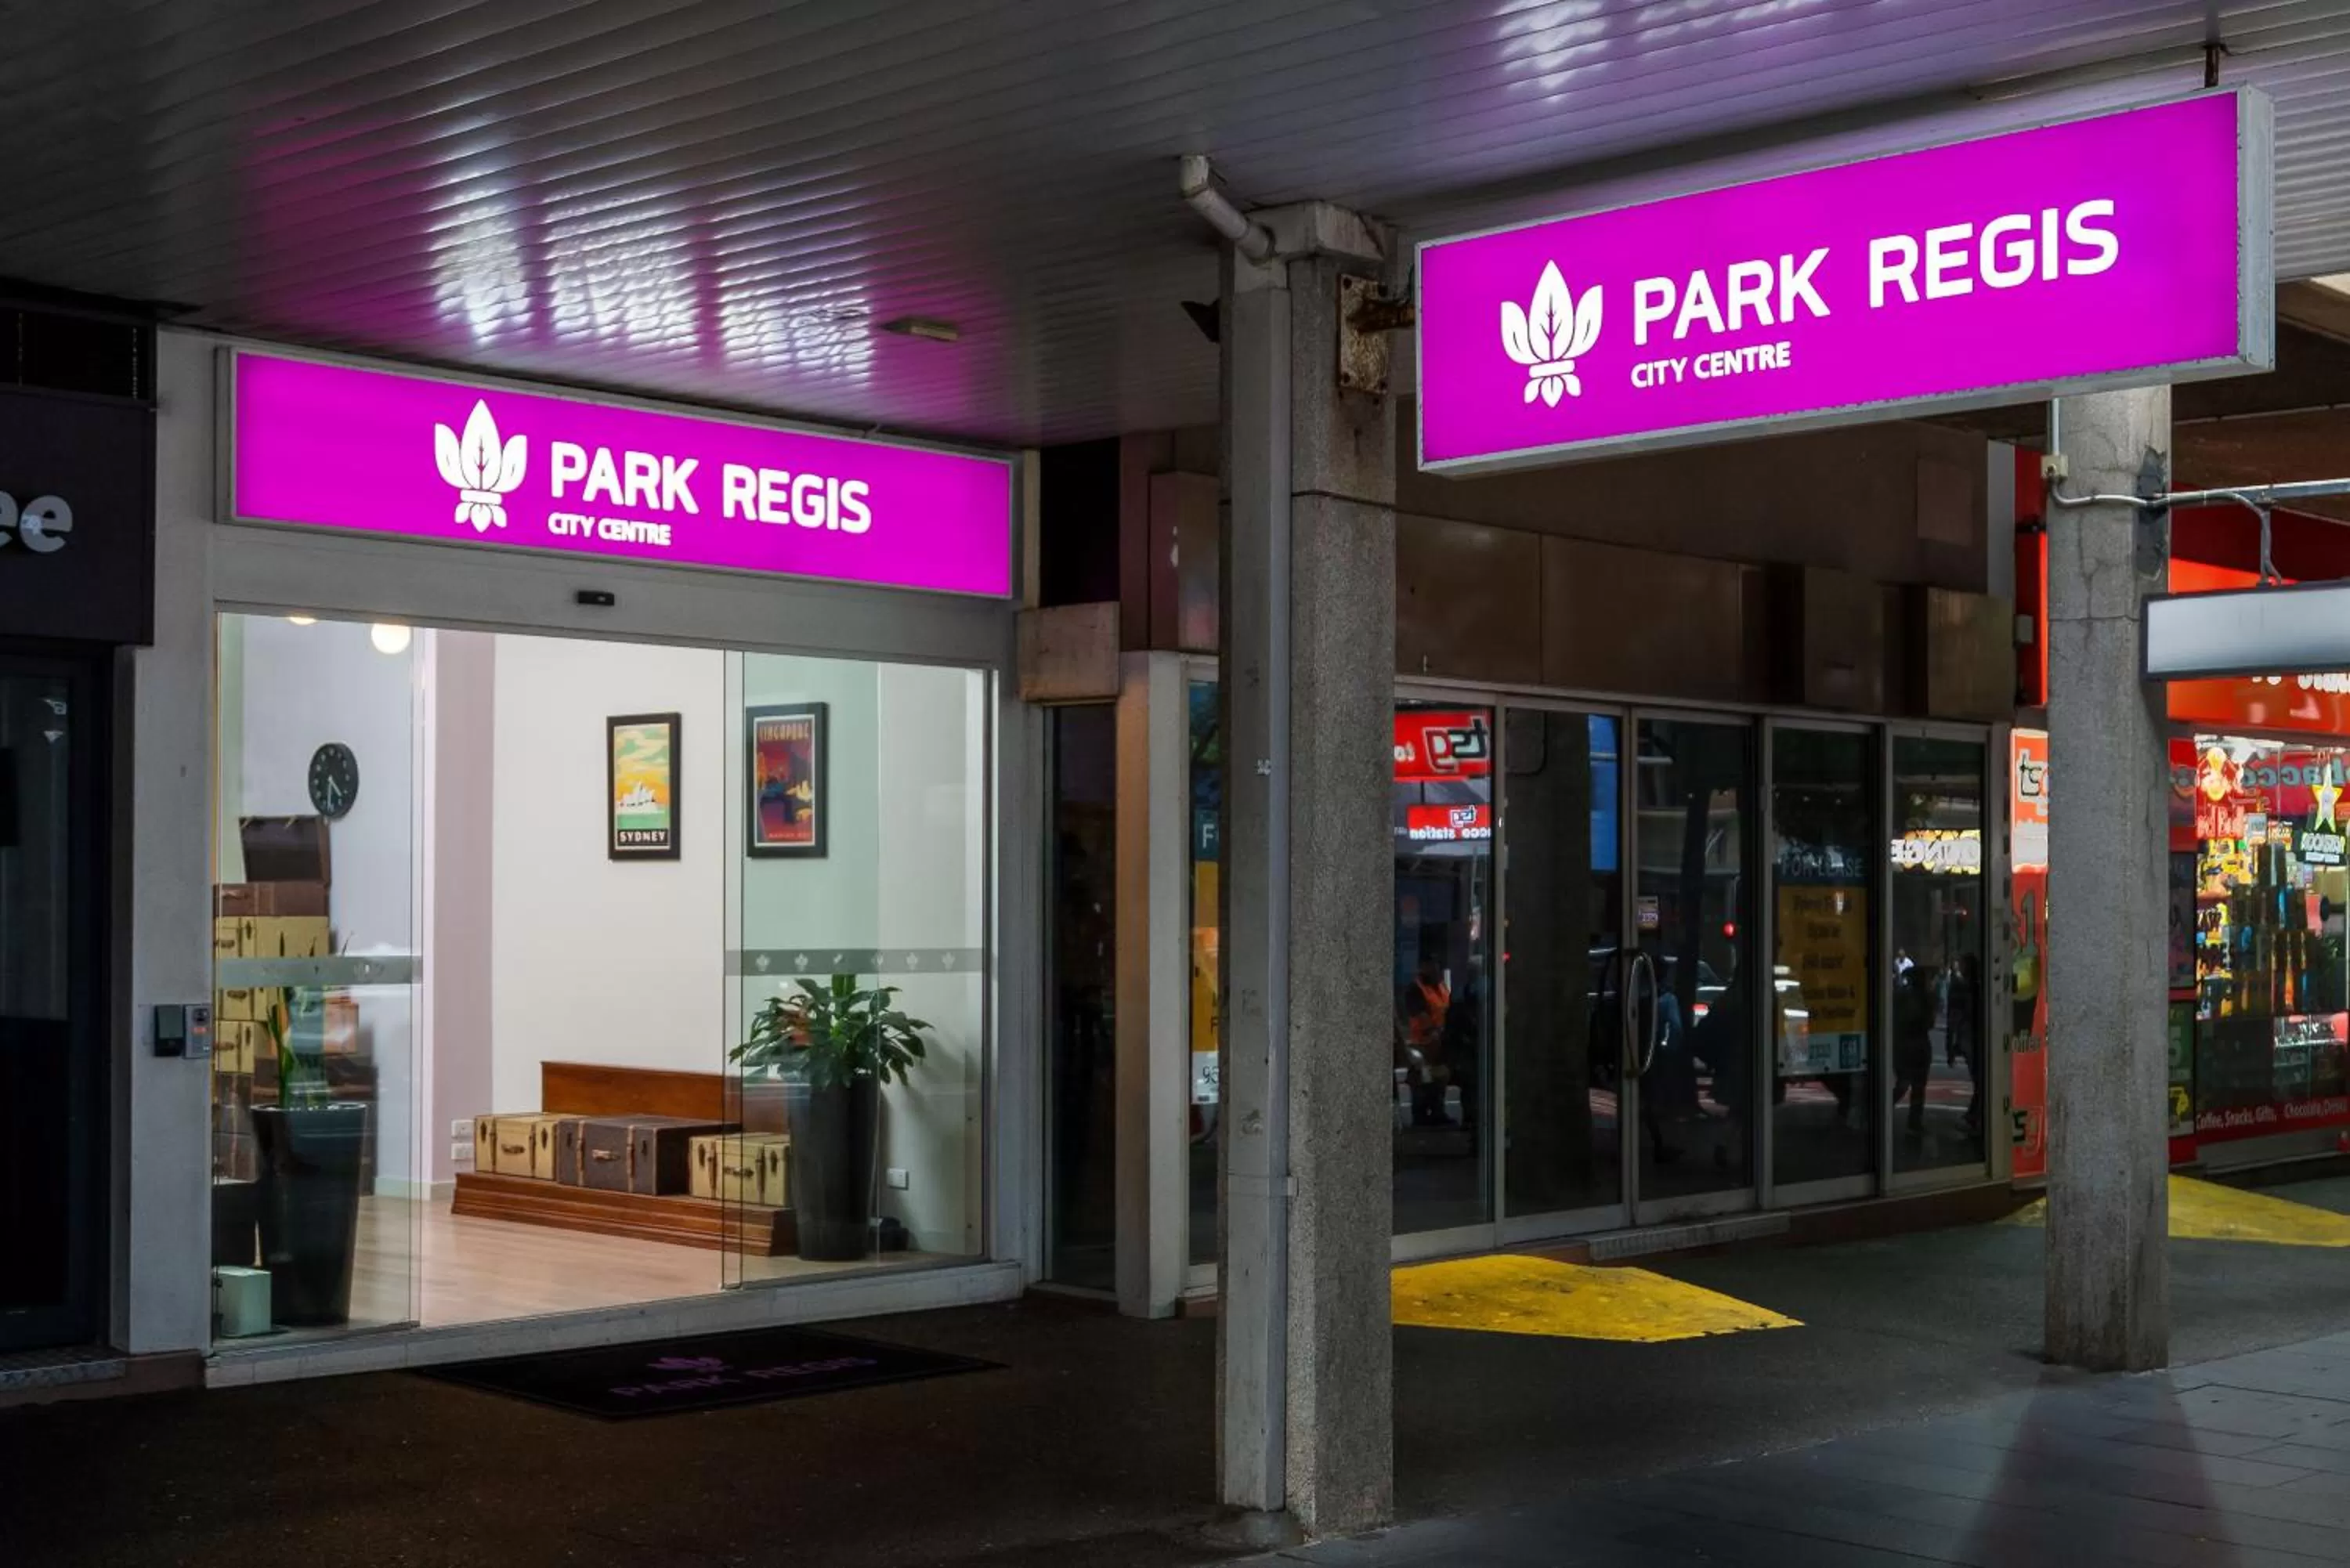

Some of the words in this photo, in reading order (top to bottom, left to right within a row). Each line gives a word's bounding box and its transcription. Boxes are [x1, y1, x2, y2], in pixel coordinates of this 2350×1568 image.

[1634, 247, 1831, 345] PARK
[1869, 199, 2120, 308] REGIS
[1631, 356, 1688, 388] CITY
[1694, 341, 1791, 379] CENTRE
[551, 441, 700, 515] PARK
[722, 463, 872, 533] REGIS
[548, 512, 595, 537] CITY
[598, 518, 671, 546] CENTRE
[620, 829, 666, 843] SYDNEY
